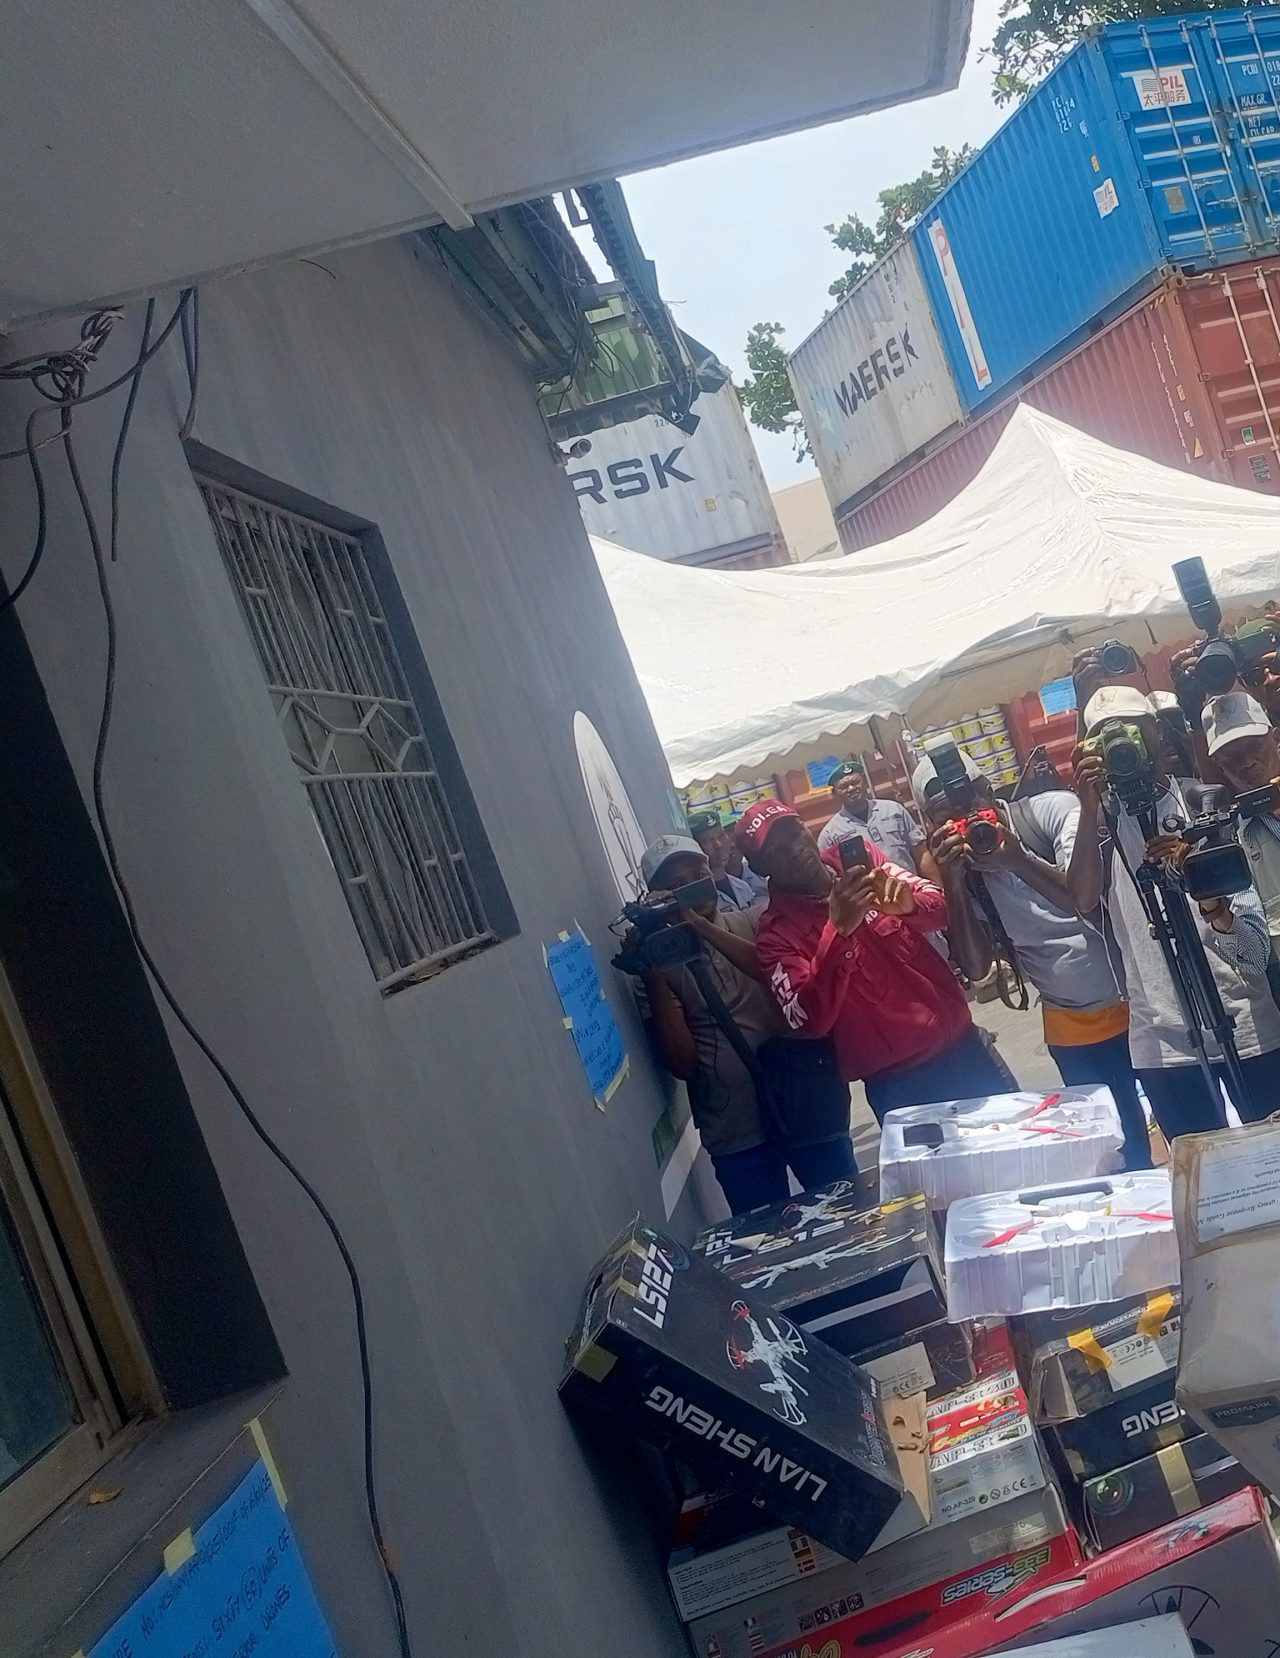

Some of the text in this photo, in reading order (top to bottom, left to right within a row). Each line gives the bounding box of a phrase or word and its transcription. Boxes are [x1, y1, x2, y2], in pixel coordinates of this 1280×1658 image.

[1241, 63, 1259, 76] PCIU
[1160, 75, 1184, 89] PIL
[833, 324, 920, 419] MAERSK
[1215, 1400, 1273, 1419] PROMARK
[645, 1385, 828, 1502] LIAN SHENG
